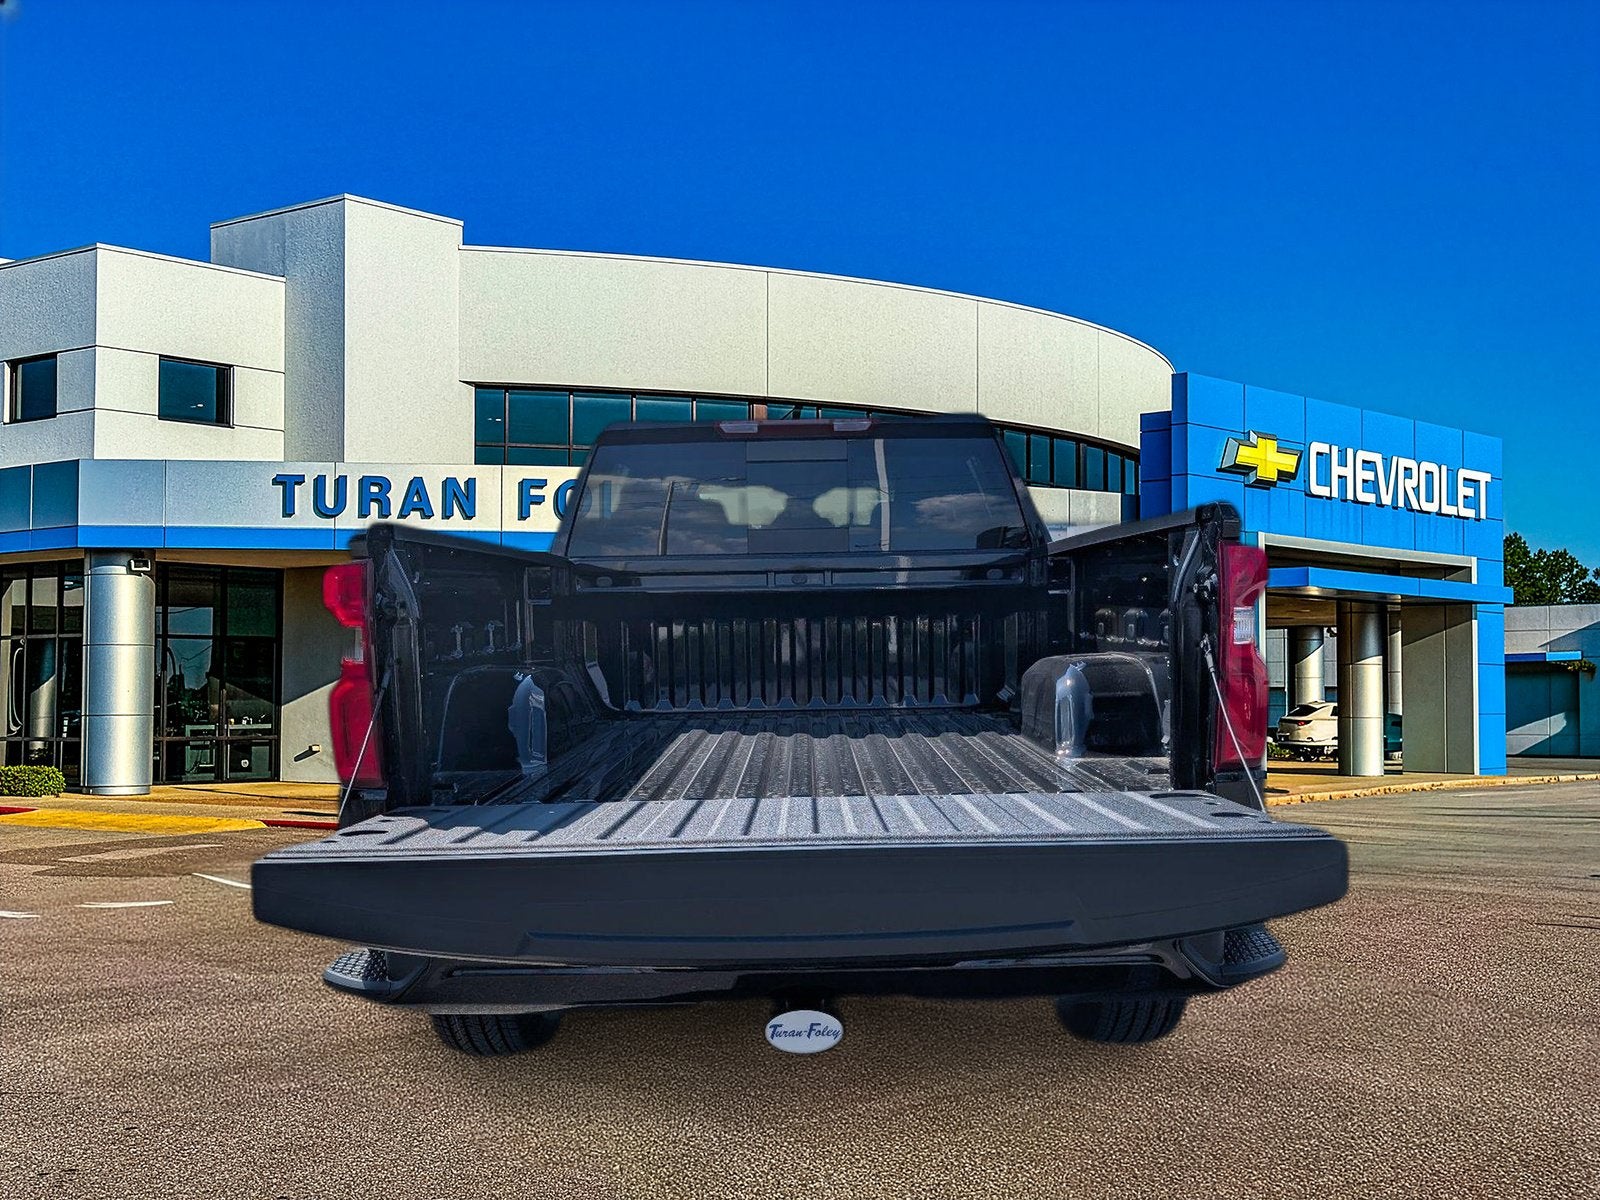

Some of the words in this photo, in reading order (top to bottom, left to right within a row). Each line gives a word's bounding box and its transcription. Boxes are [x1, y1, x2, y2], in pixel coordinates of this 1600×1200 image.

[272, 473, 477, 520] TURAN
[1306, 441, 1493, 521] CHEVROLET
[768, 1022, 841, 1041] Turan-Foley
